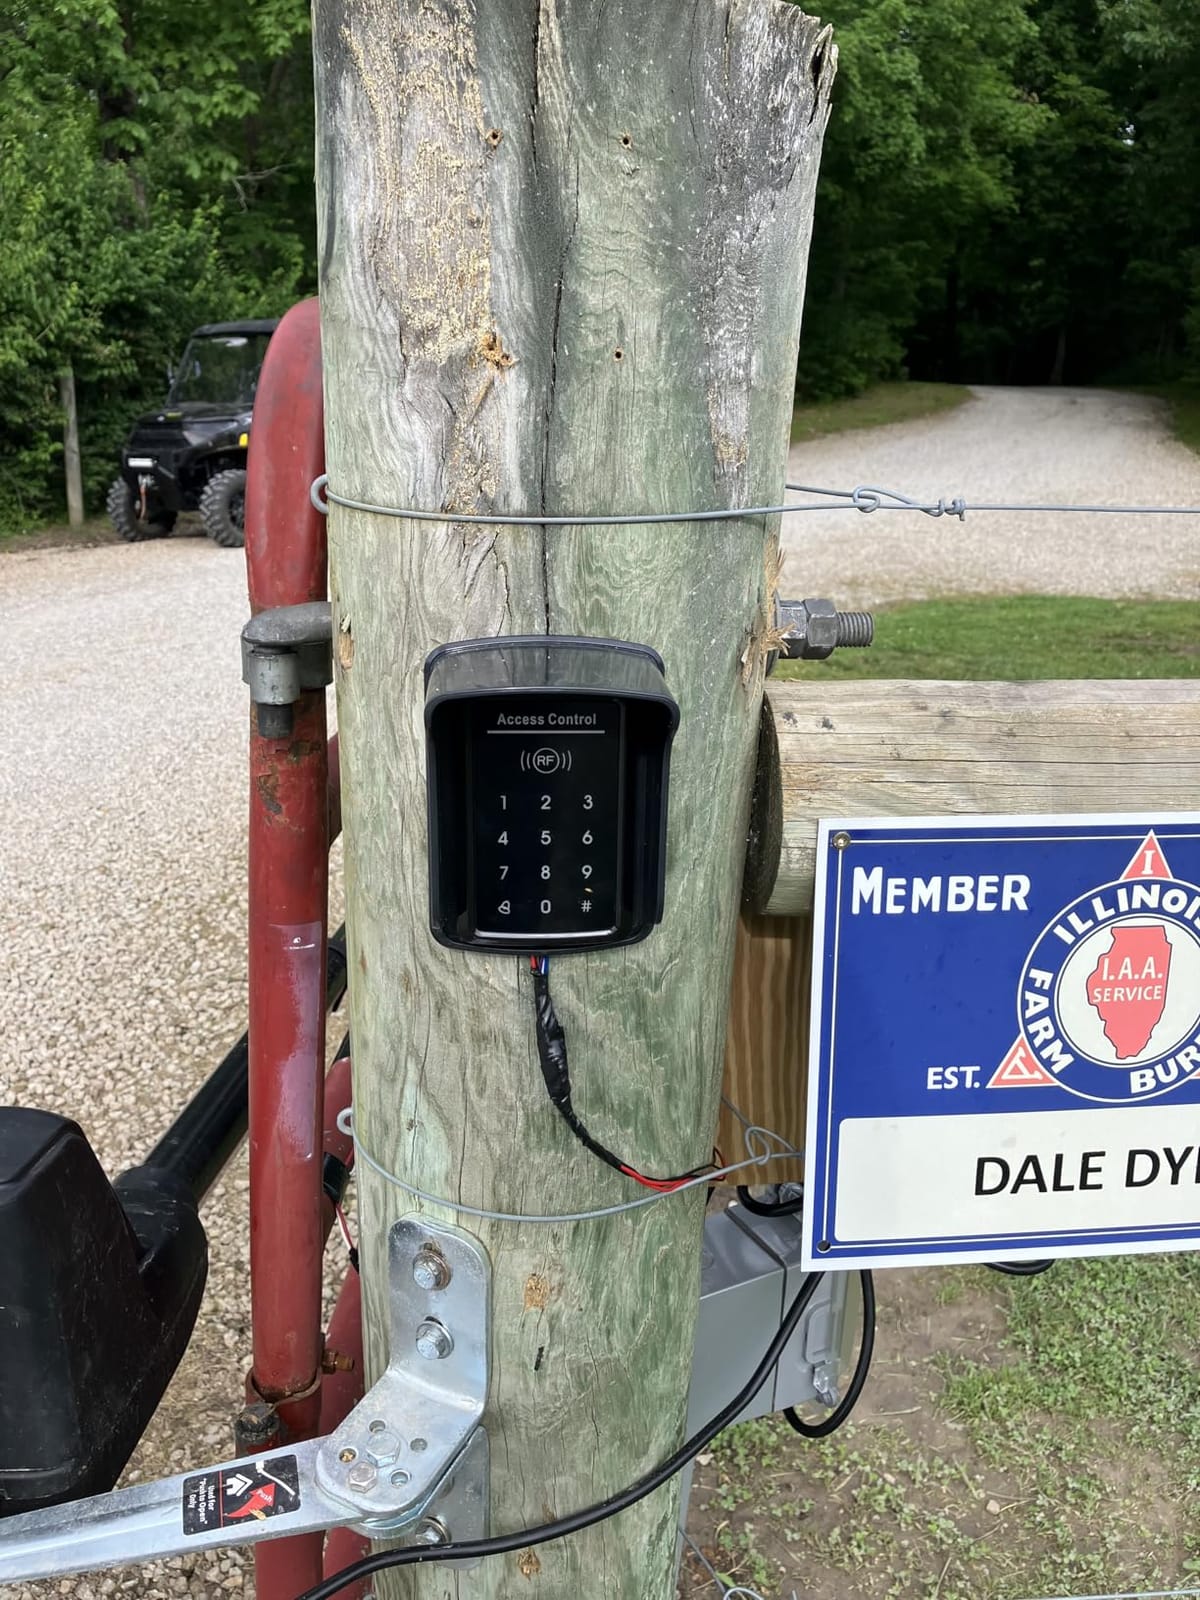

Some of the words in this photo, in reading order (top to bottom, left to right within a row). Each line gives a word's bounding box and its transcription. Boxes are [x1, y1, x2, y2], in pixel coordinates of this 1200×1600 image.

[497, 713, 545, 725] Access
[548, 713, 597, 725] Control
[537, 755, 555, 766] RF
[500, 795, 507, 810] 1
[541, 795, 551, 810] 2
[583, 795, 593, 810] 3
[498, 831, 508, 845] 4
[540, 831, 551, 845] 5
[582, 830, 593, 845] 6
[499, 865, 509, 880] 7
[540, 865, 551, 880] 8
[581, 864, 592, 879] 9
[851, 866, 1031, 915] MEMBER
[540, 900, 551, 914] 0
[581, 900, 592, 913] #
[1052, 884, 1200, 945] ILLINOI
[1102, 956, 1163, 981] I.A.A.
[1092, 985, 1163, 1003] SERVICE
[1024, 968, 1074, 1074] FARM
[1129, 1035, 1200, 1094] BUR
[926, 1065, 981, 1090] EST.
[974, 1150, 1107, 1196] DALE
[1125, 1146, 1200, 1188] DY
